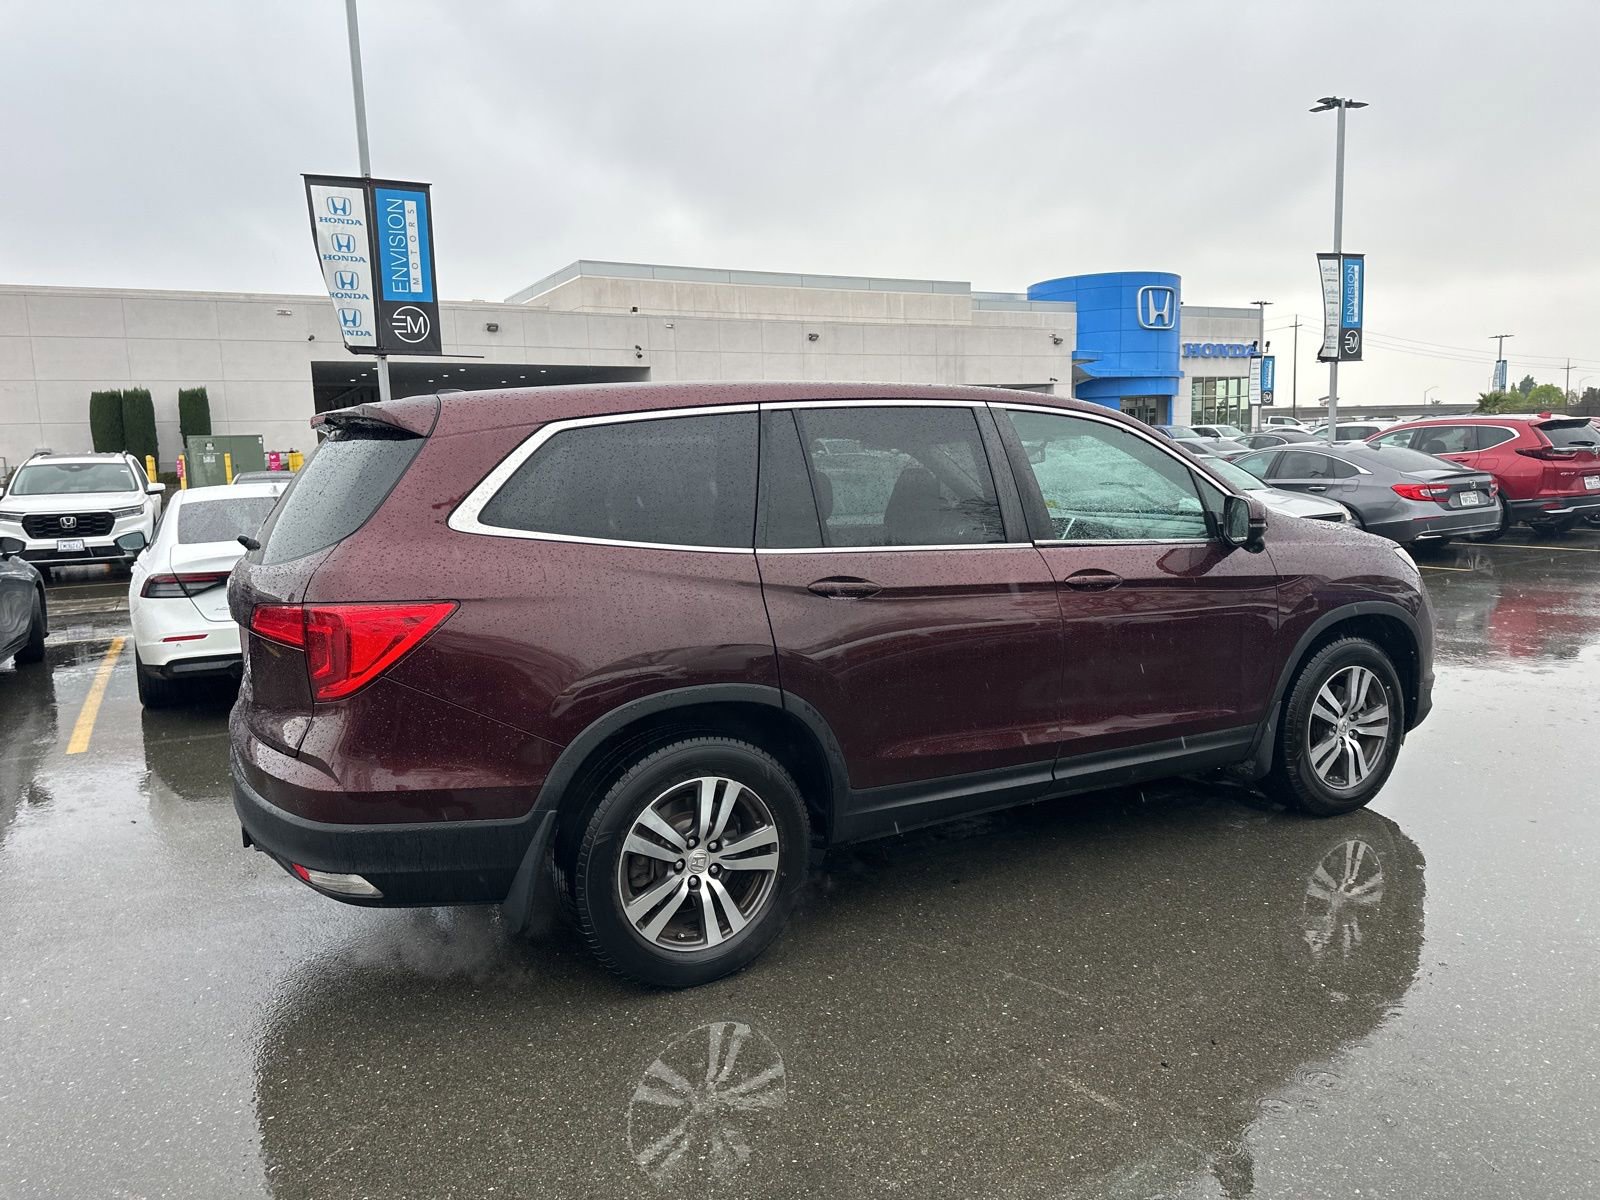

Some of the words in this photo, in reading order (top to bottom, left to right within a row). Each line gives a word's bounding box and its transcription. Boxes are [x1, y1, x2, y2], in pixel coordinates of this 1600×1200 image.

[319, 217, 363, 226] HONDA
[323, 254, 366, 263] HONDA
[386, 198, 409, 293] ENVISION
[408, 209, 420, 285] MOTORS
[1346, 264, 1355, 323] ENVISION
[1182, 343, 1260, 358] HONDA
